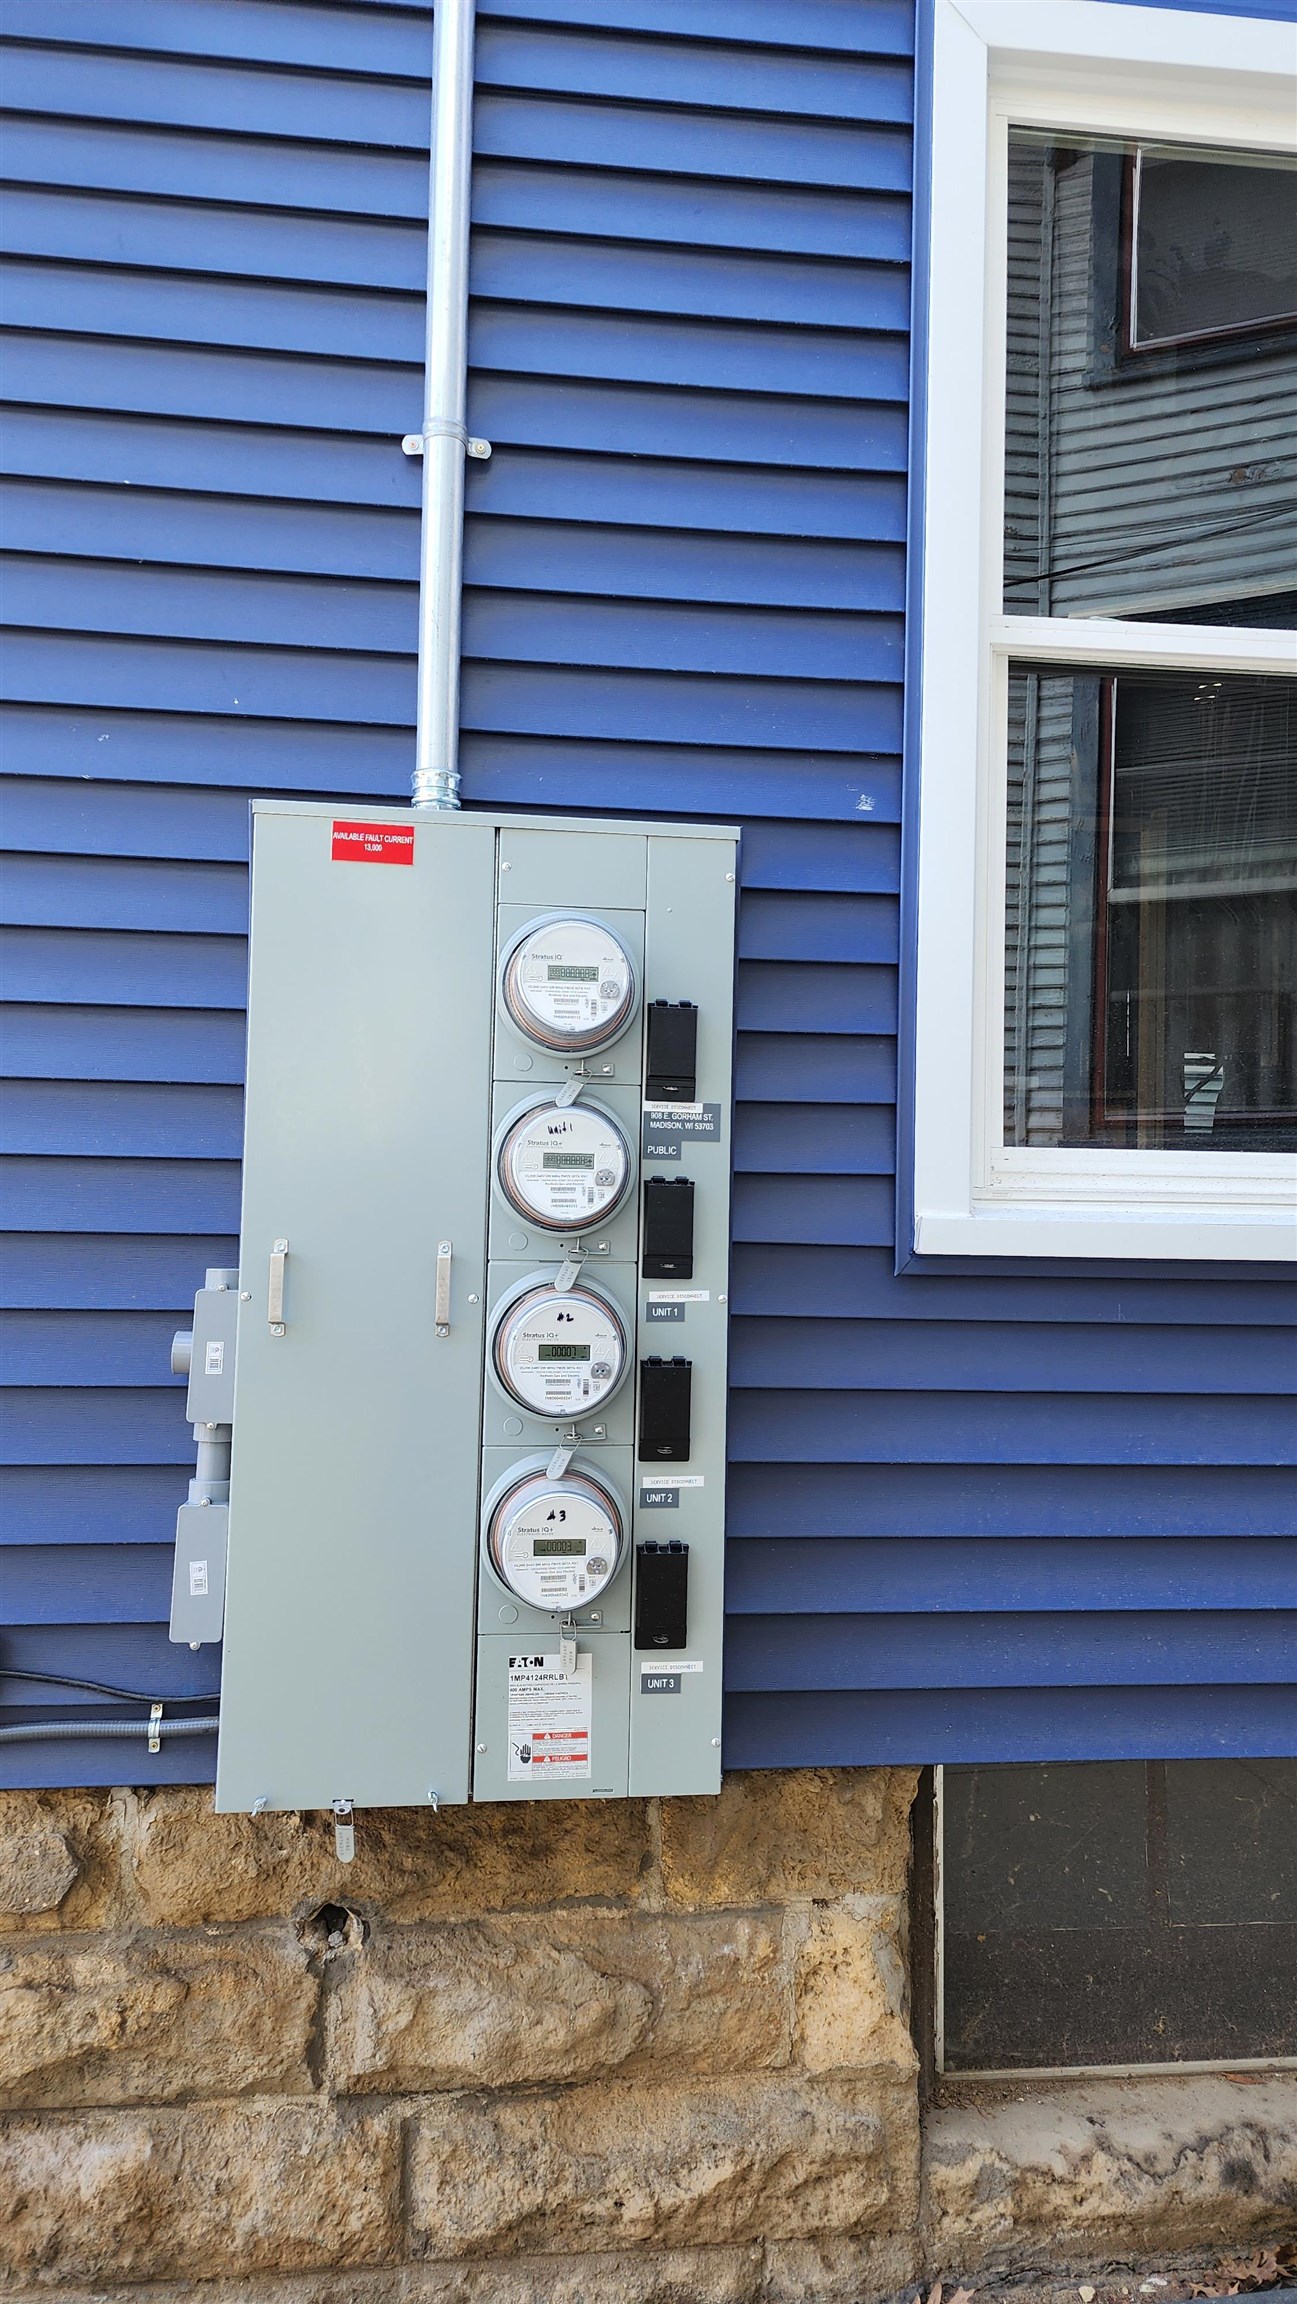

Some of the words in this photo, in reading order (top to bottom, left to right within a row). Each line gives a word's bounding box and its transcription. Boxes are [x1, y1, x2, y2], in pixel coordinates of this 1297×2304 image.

[333, 831, 364, 841] AVAILABLE
[365, 834, 384, 842] FAULT
[384, 835, 413, 844] CURRENT
[364, 843, 382, 852] 13,000
[671, 1113, 702, 1121] GORHAM
[703, 1113, 713, 1121] ST.
[650, 1121, 683, 1130] MADISON,
[647, 1145, 677, 1155] PUBLIC
[652, 1307, 672, 1317] UNIT
[673, 1307, 678, 1316] 1
[646, 1493, 666, 1503] UNIT
[667, 1493, 673, 1502] 2
[509, 1656, 544, 1668] EATON
[647, 1678, 668, 1689] UNIT
[669, 1678, 674, 1688] 3
